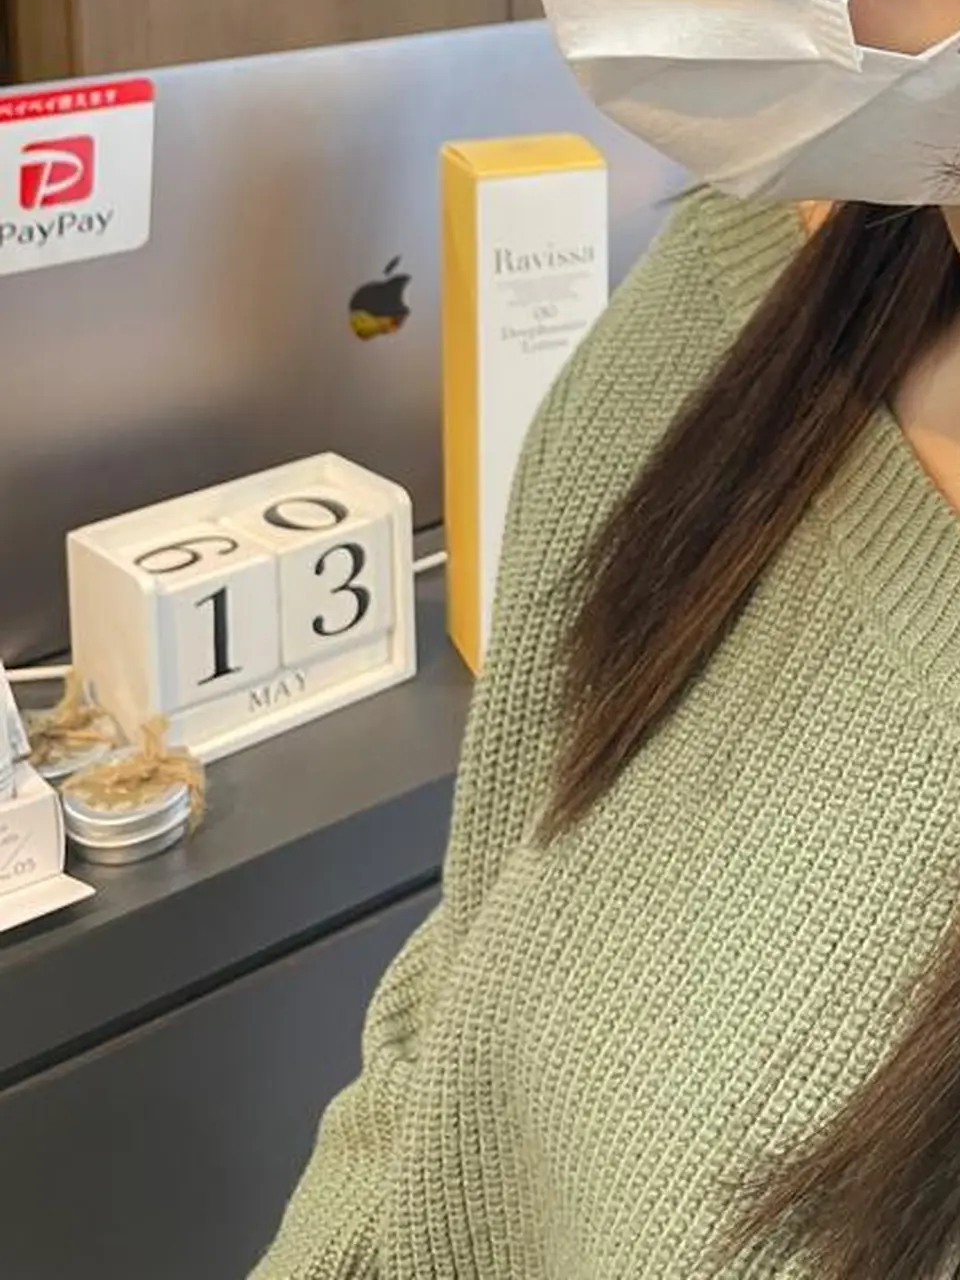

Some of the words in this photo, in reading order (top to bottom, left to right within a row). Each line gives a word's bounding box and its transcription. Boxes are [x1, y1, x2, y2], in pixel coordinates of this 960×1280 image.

[0, 208, 115, 248] PayPay
[494, 241, 595, 276] Ravissa
[248, 671, 308, 712] MAY
